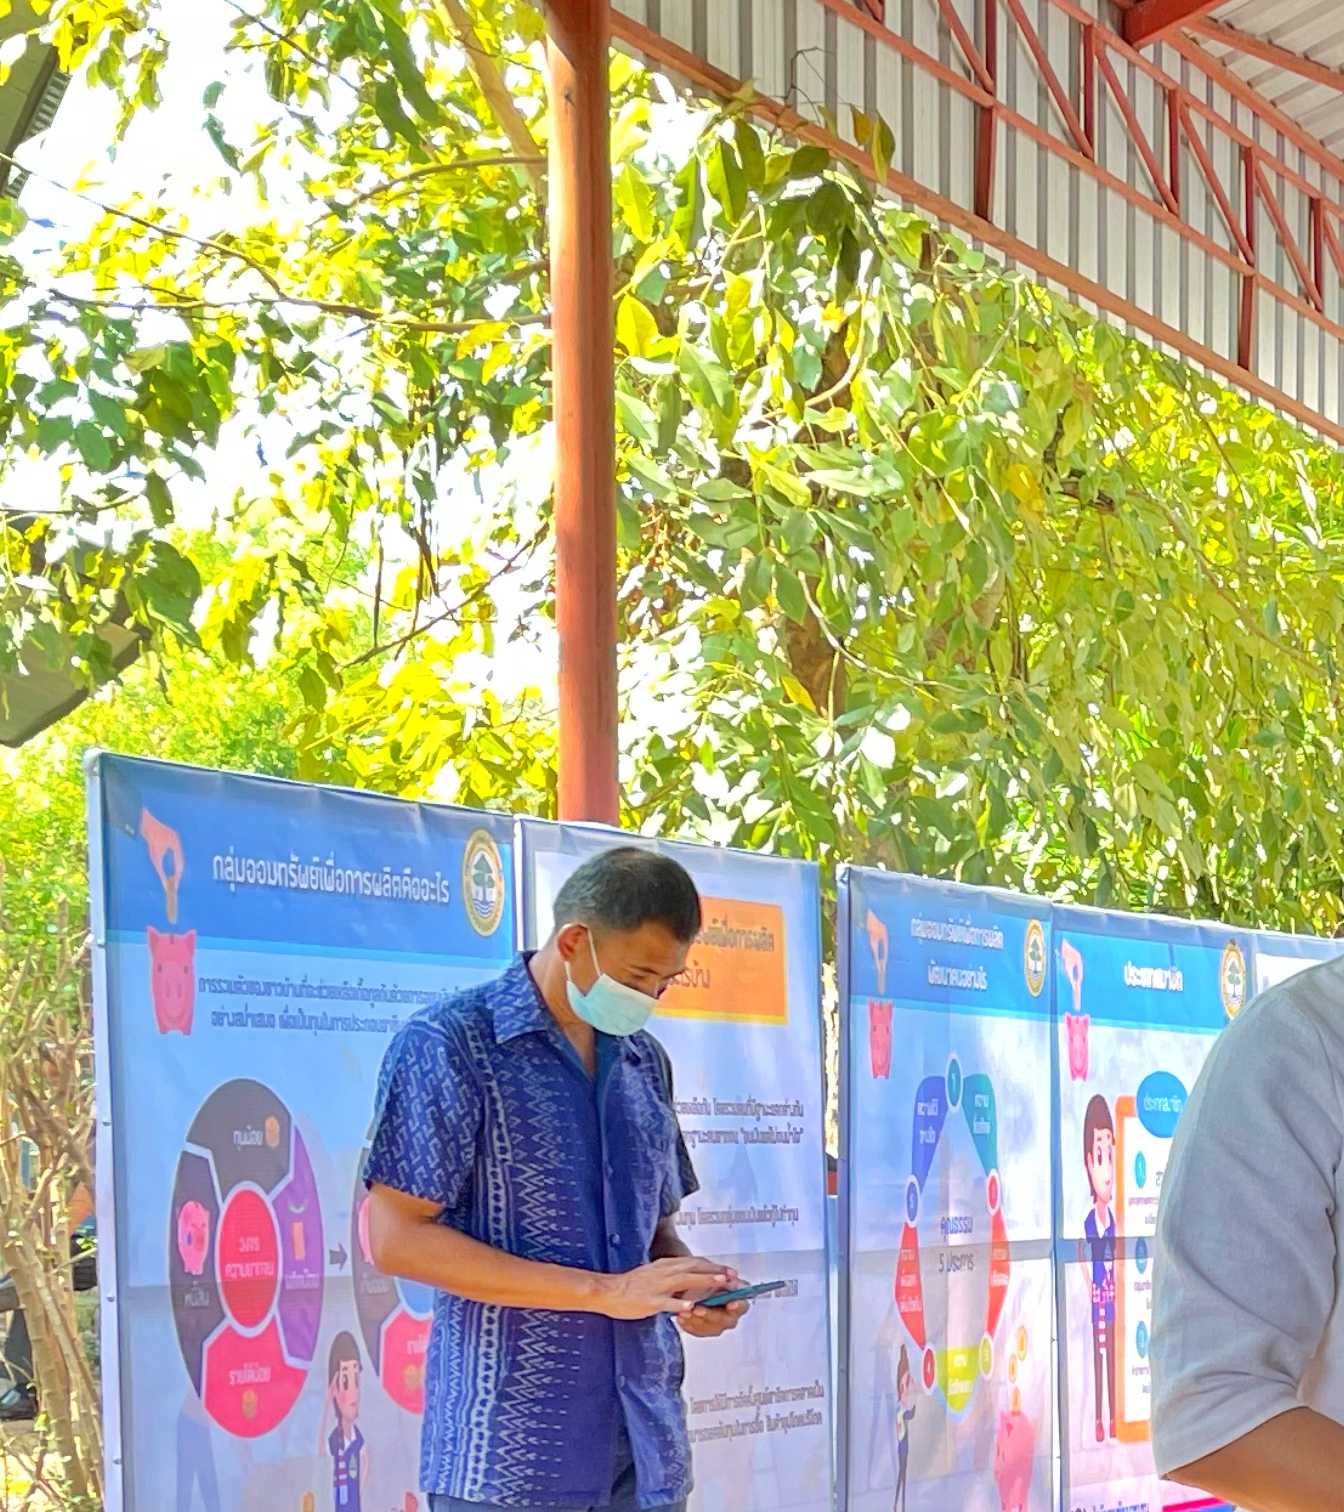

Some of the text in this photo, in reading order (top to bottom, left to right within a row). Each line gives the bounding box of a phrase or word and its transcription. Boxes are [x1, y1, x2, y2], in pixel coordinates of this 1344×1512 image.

[212, 845, 450, 904] กลุ่มออมทรัพย์เพื่อการผลิตคืออะไร
